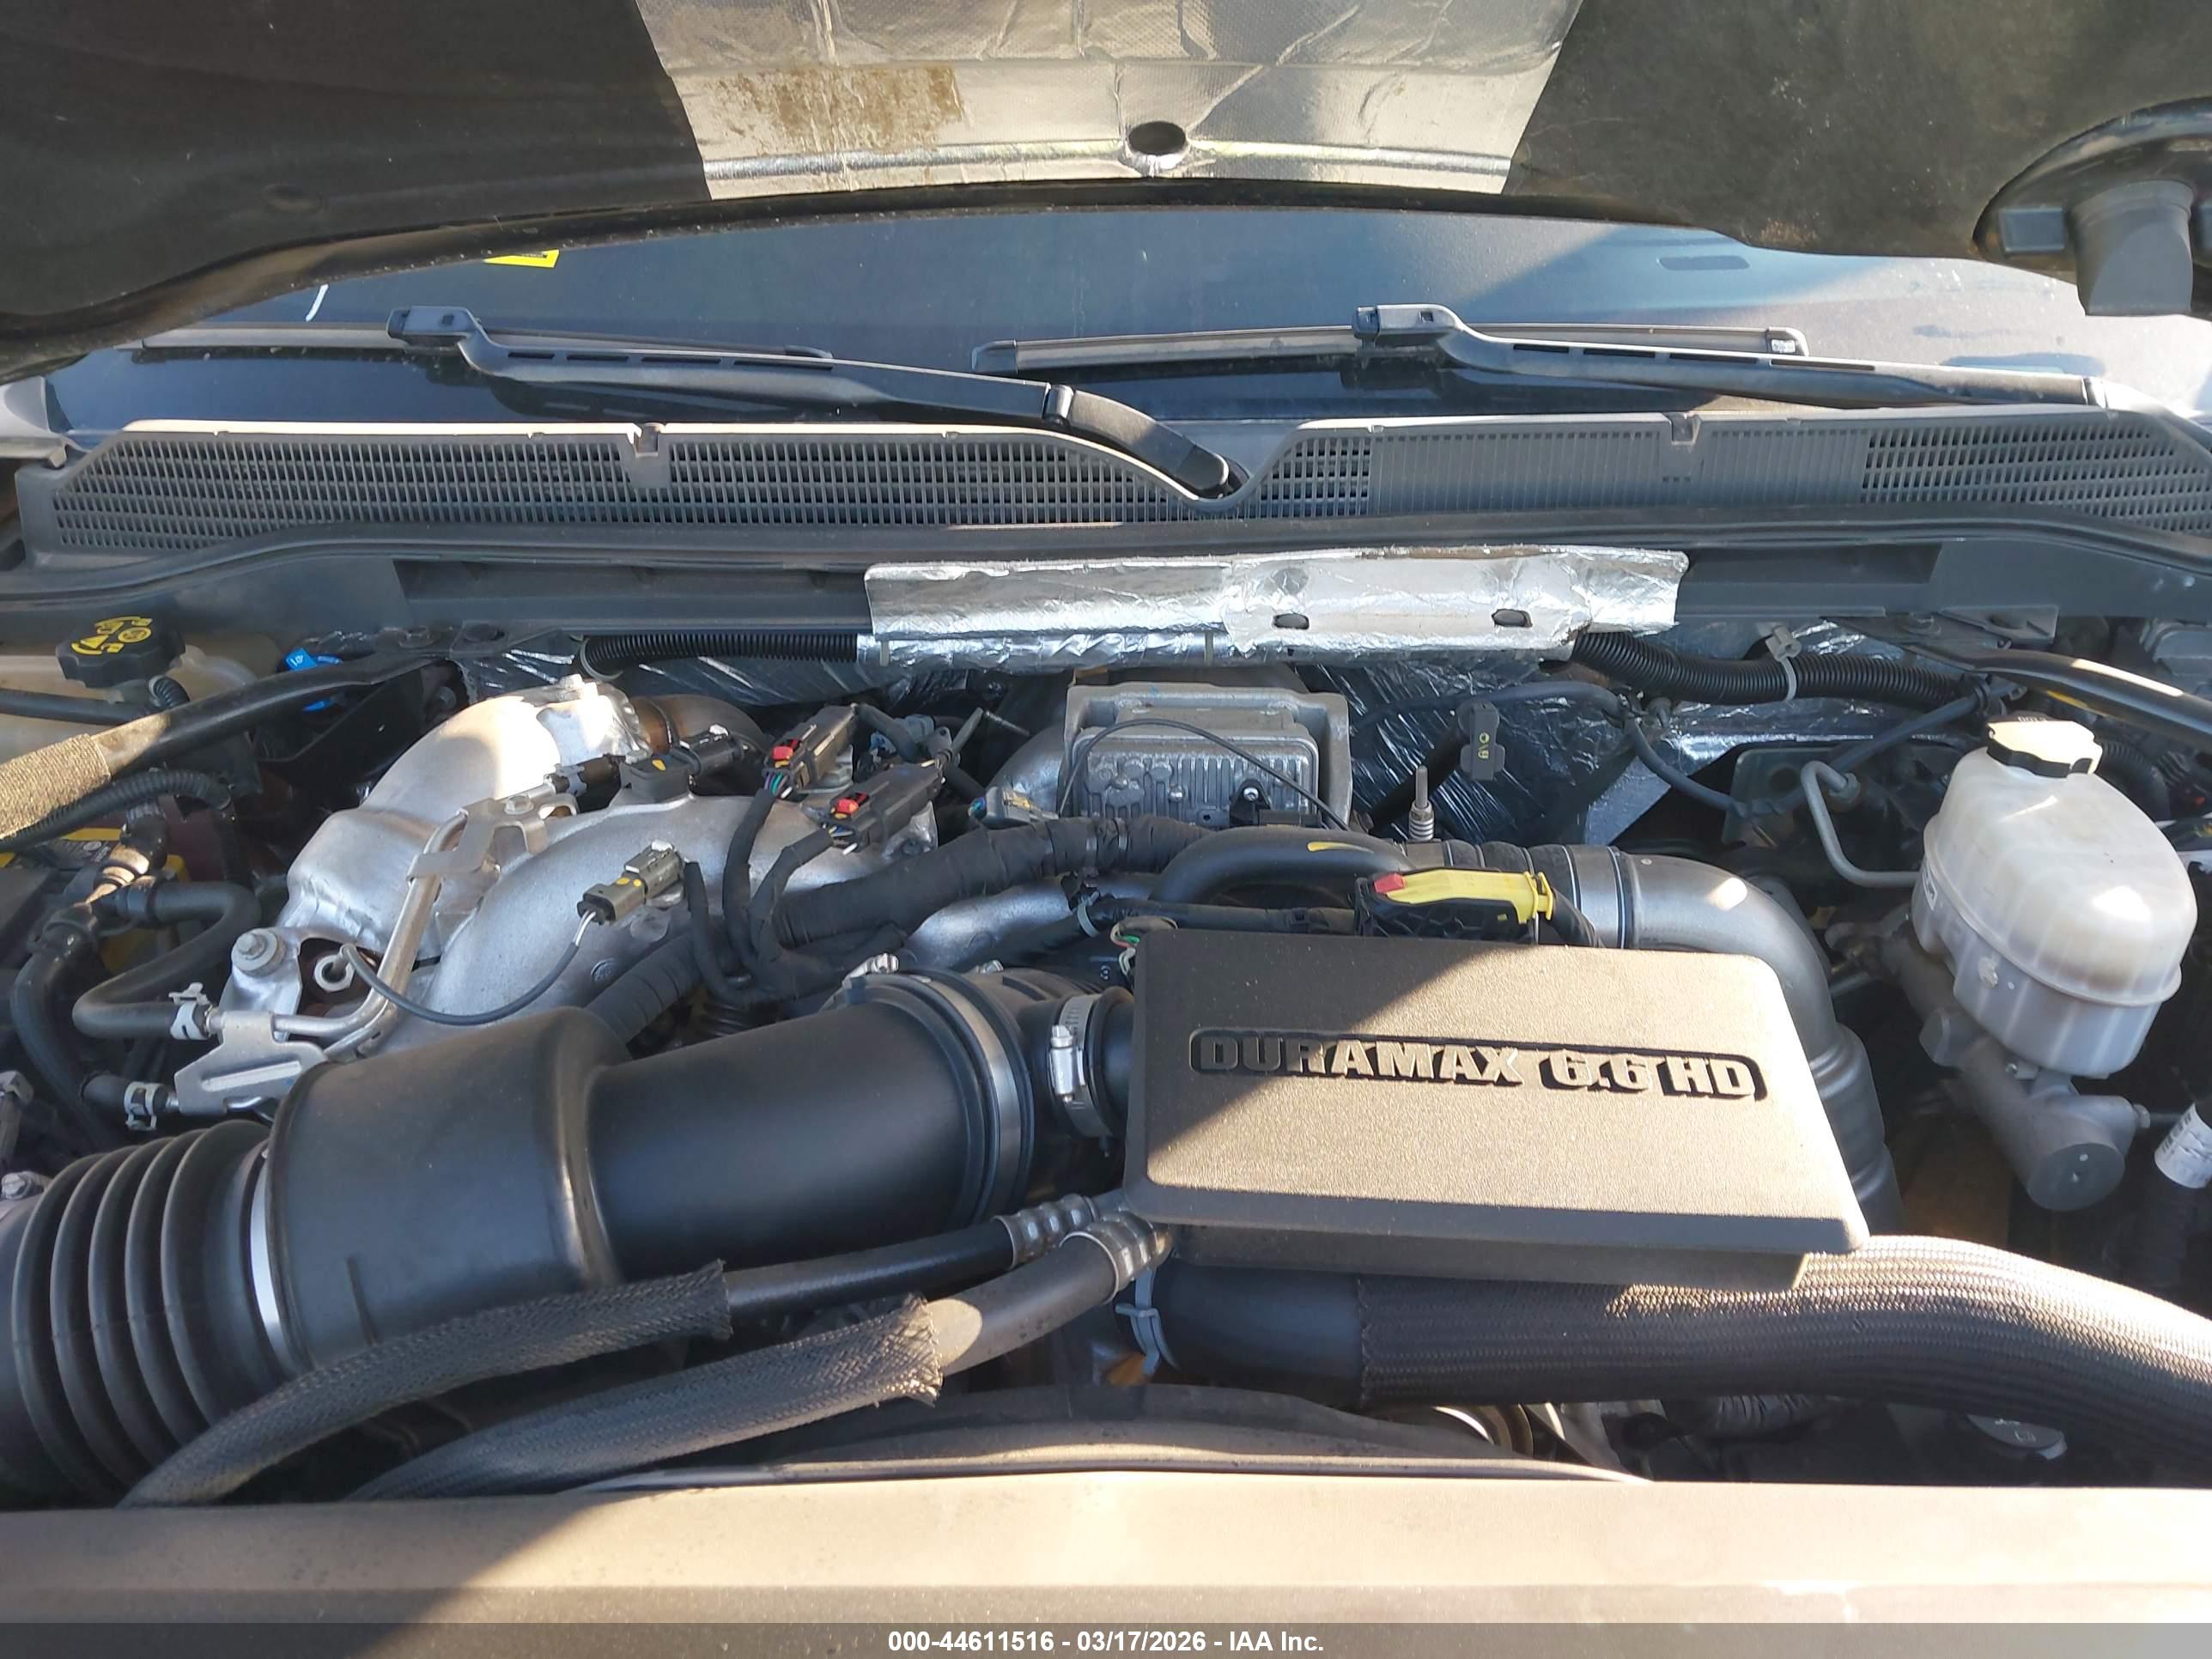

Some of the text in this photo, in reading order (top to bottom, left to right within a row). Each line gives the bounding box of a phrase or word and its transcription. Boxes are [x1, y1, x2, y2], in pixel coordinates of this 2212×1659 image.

[1200, 1036, 1757, 1097] DURAMAX 6.6 HD
